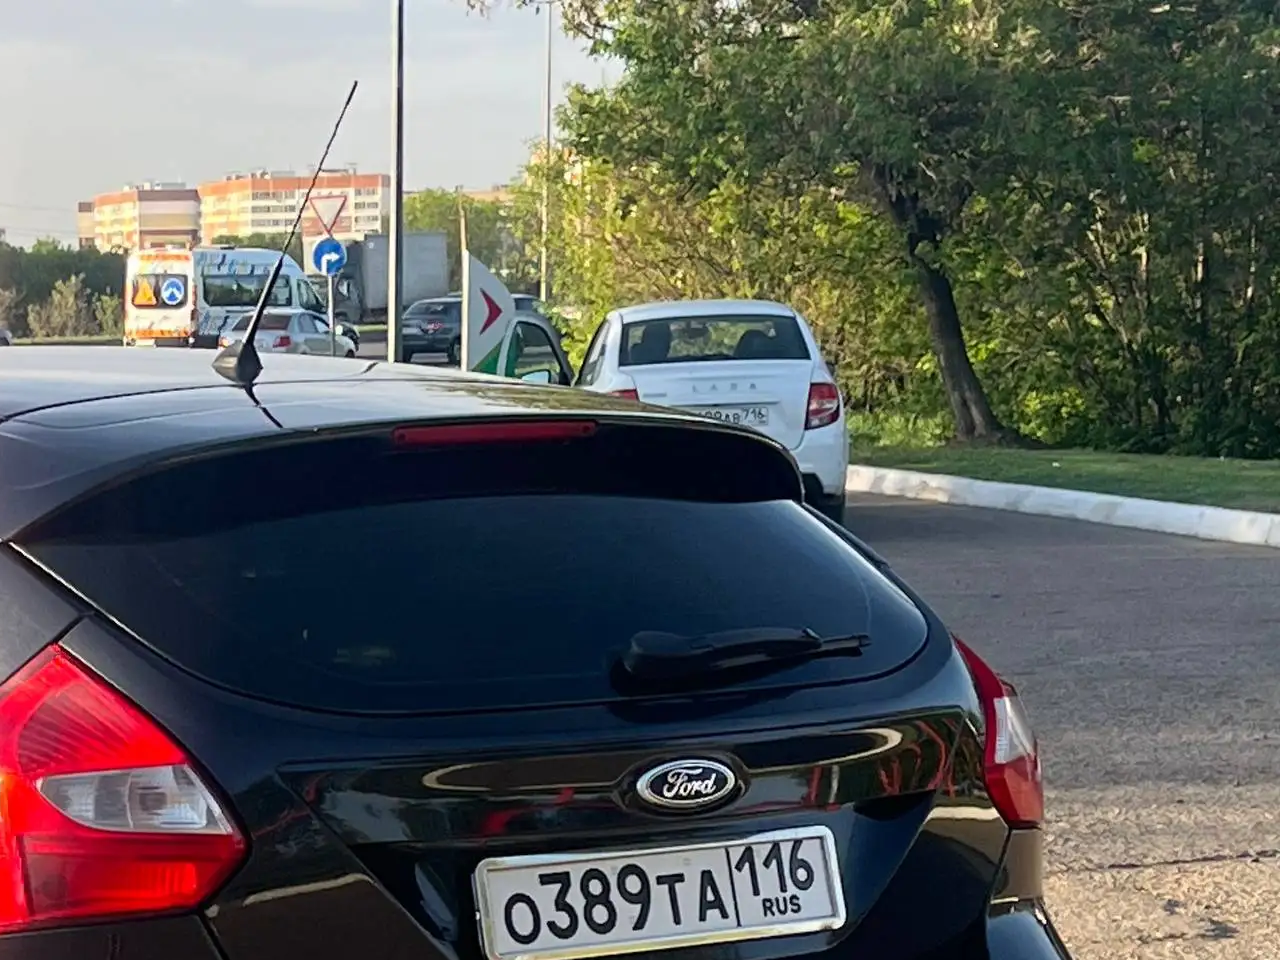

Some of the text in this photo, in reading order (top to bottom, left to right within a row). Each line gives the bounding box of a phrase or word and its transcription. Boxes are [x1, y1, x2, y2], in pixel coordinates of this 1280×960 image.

[663, 767, 717, 798] Ford
[504, 839, 814, 945] О389ТА 116
[762, 893, 802, 918] RUS
